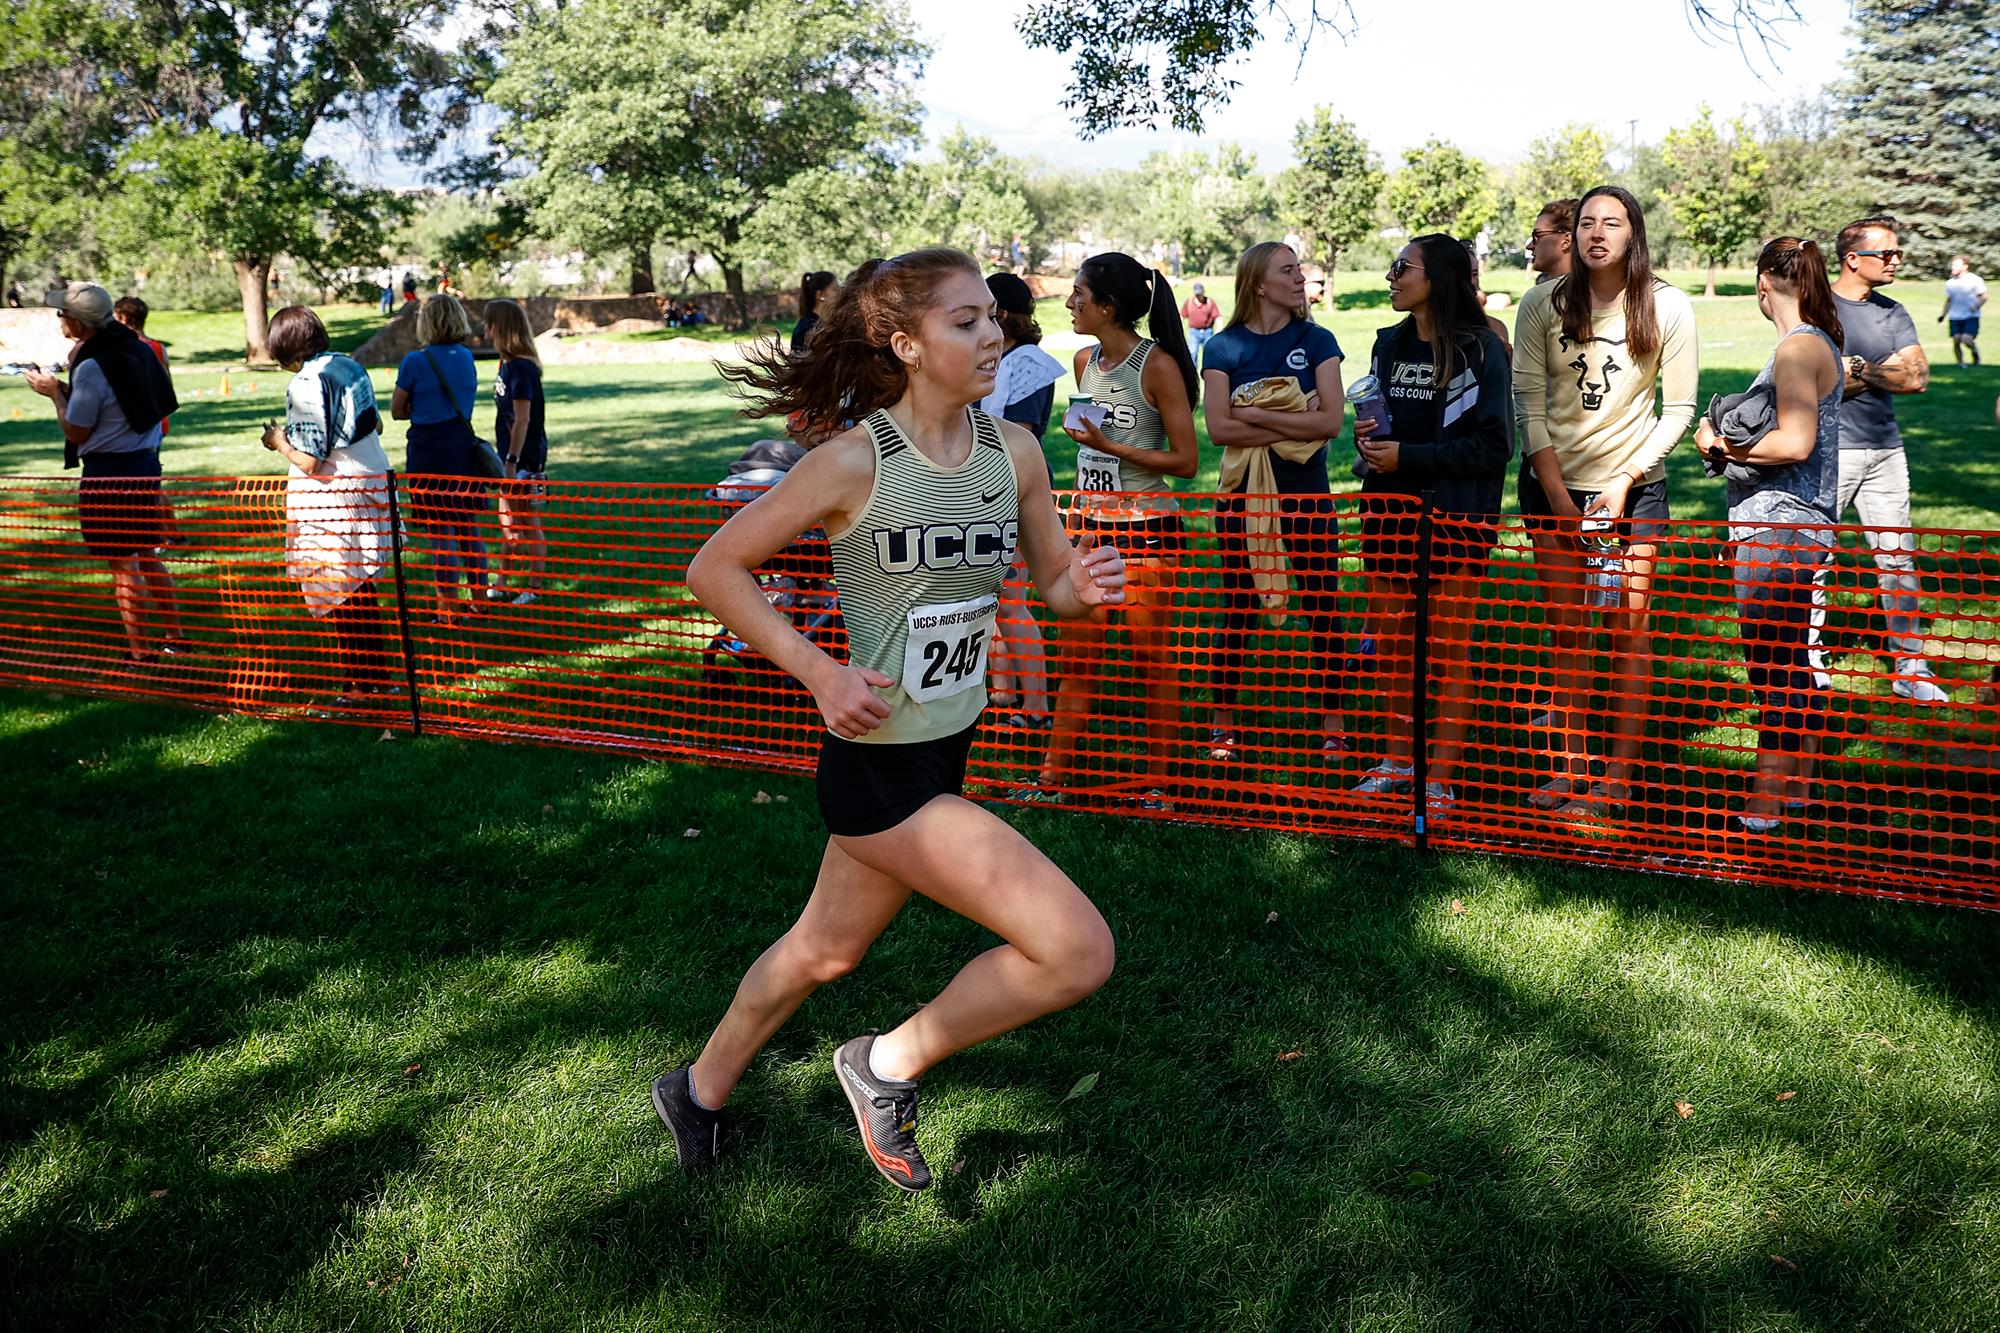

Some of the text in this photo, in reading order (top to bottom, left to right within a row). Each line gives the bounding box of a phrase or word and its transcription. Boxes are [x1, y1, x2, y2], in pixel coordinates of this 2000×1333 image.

[1390, 387, 1436, 400] OSS COUN
[1082, 466, 1114, 492] 238
[913, 616, 938, 630] UCCS
[921, 628, 986, 690] 245
